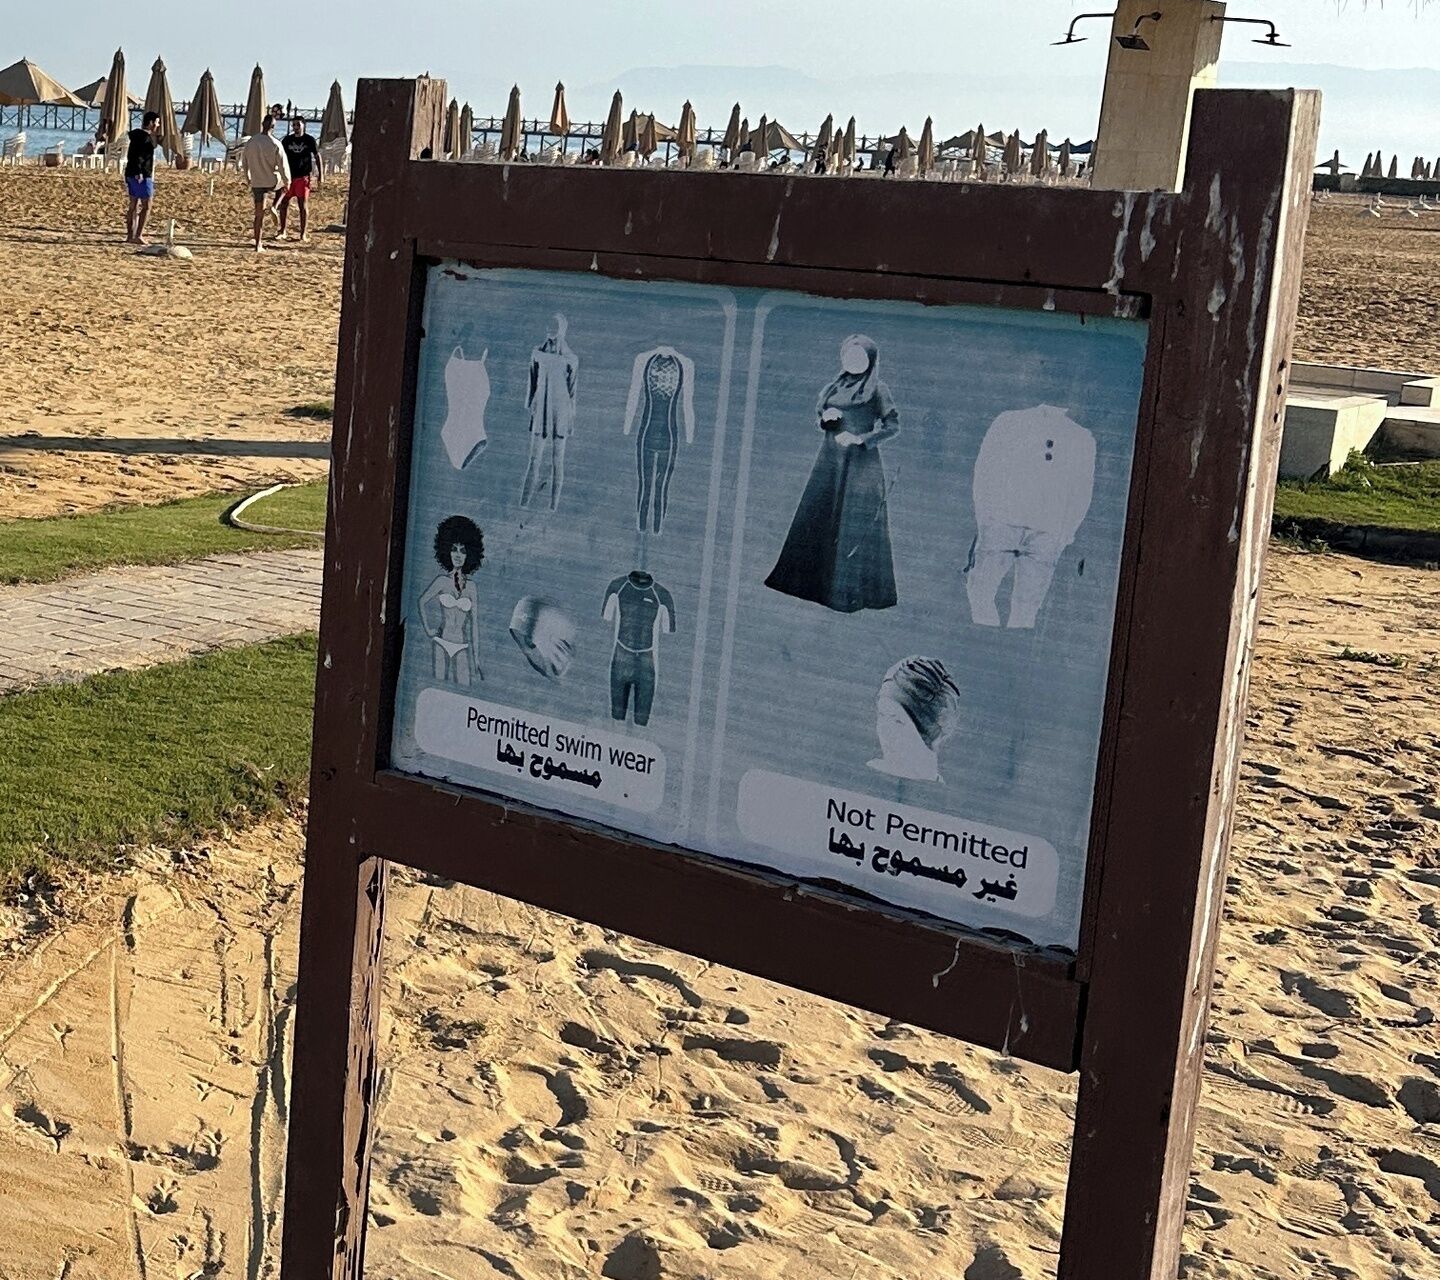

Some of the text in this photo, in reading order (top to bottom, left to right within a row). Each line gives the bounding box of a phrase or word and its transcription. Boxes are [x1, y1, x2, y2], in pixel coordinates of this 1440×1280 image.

[467, 706, 655, 774] Permitted swim wear
[496, 739, 602, 789] مسموح بها
[827, 798, 1028, 869] Not Permitted
[828, 827, 1017, 902] غير مسموح بها
